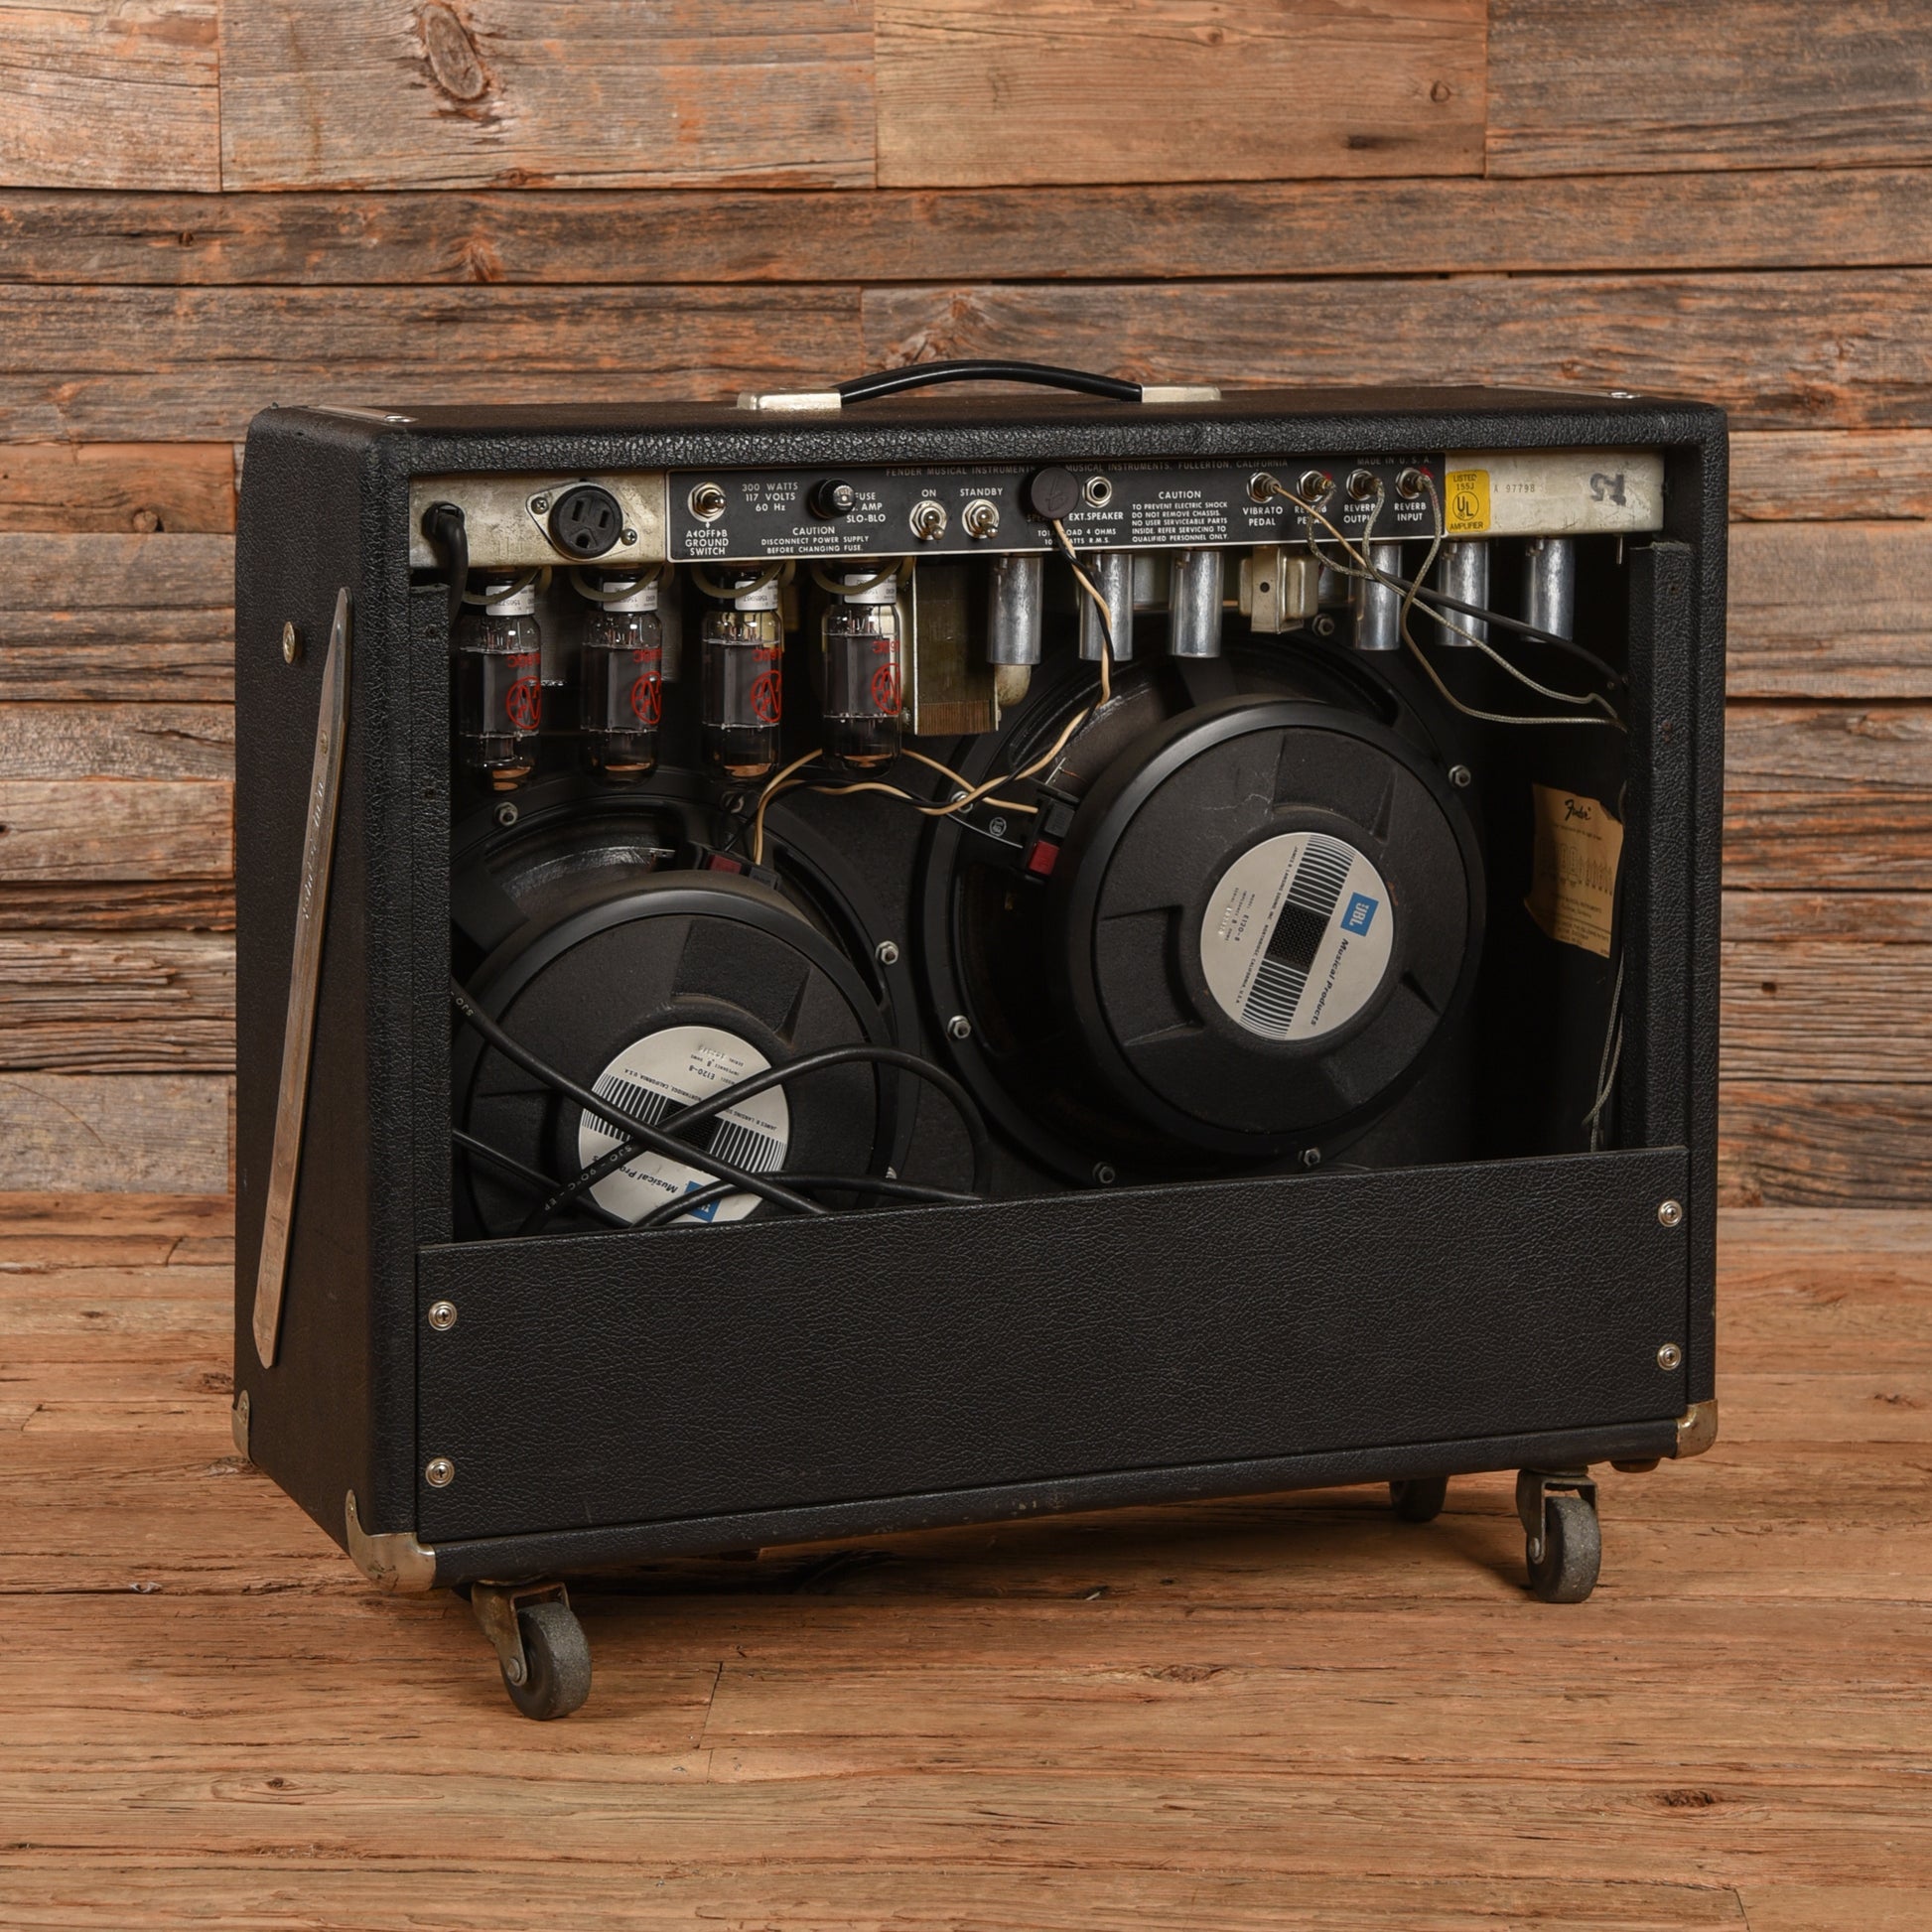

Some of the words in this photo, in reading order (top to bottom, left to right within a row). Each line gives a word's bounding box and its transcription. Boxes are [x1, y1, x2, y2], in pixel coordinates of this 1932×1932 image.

[1236, 460, 1288, 469] CALIFORNIA
[886, 468, 922, 477] FENDER
[927, 466, 967, 475] MUSICAL
[742, 483, 760, 492] 300
[766, 483, 798, 491] WATTS
[960, 488, 1003, 496] STANDBY
[765, 492, 796, 501] VOLTS
[1158, 491, 1201, 499] CAUTION
[756, 503, 768, 512] 60
[1242, 506, 1283, 515] VIBRATO
[1394, 502, 1426, 511] REVERB
[1457, 496, 1474, 516] UL
[846, 514, 886, 523] SLO-BLO
[1248, 518, 1276, 527] PEDAL
[1450, 521, 1483, 530] AMPLIFIER
[793, 526, 835, 536] CAUTION
[685, 538, 729, 547] GROUND
[1349, 902, 1370, 926] JBL
[1235, 914, 1249, 941] E120-8
[1329, 938, 1349, 980] Musical
[1311, 980, 1333, 1026] Products
[689, 1065, 715, 1080] E120-8
[610, 1146, 632, 1162] SJO
[637, 1173, 679, 1194] Musical
